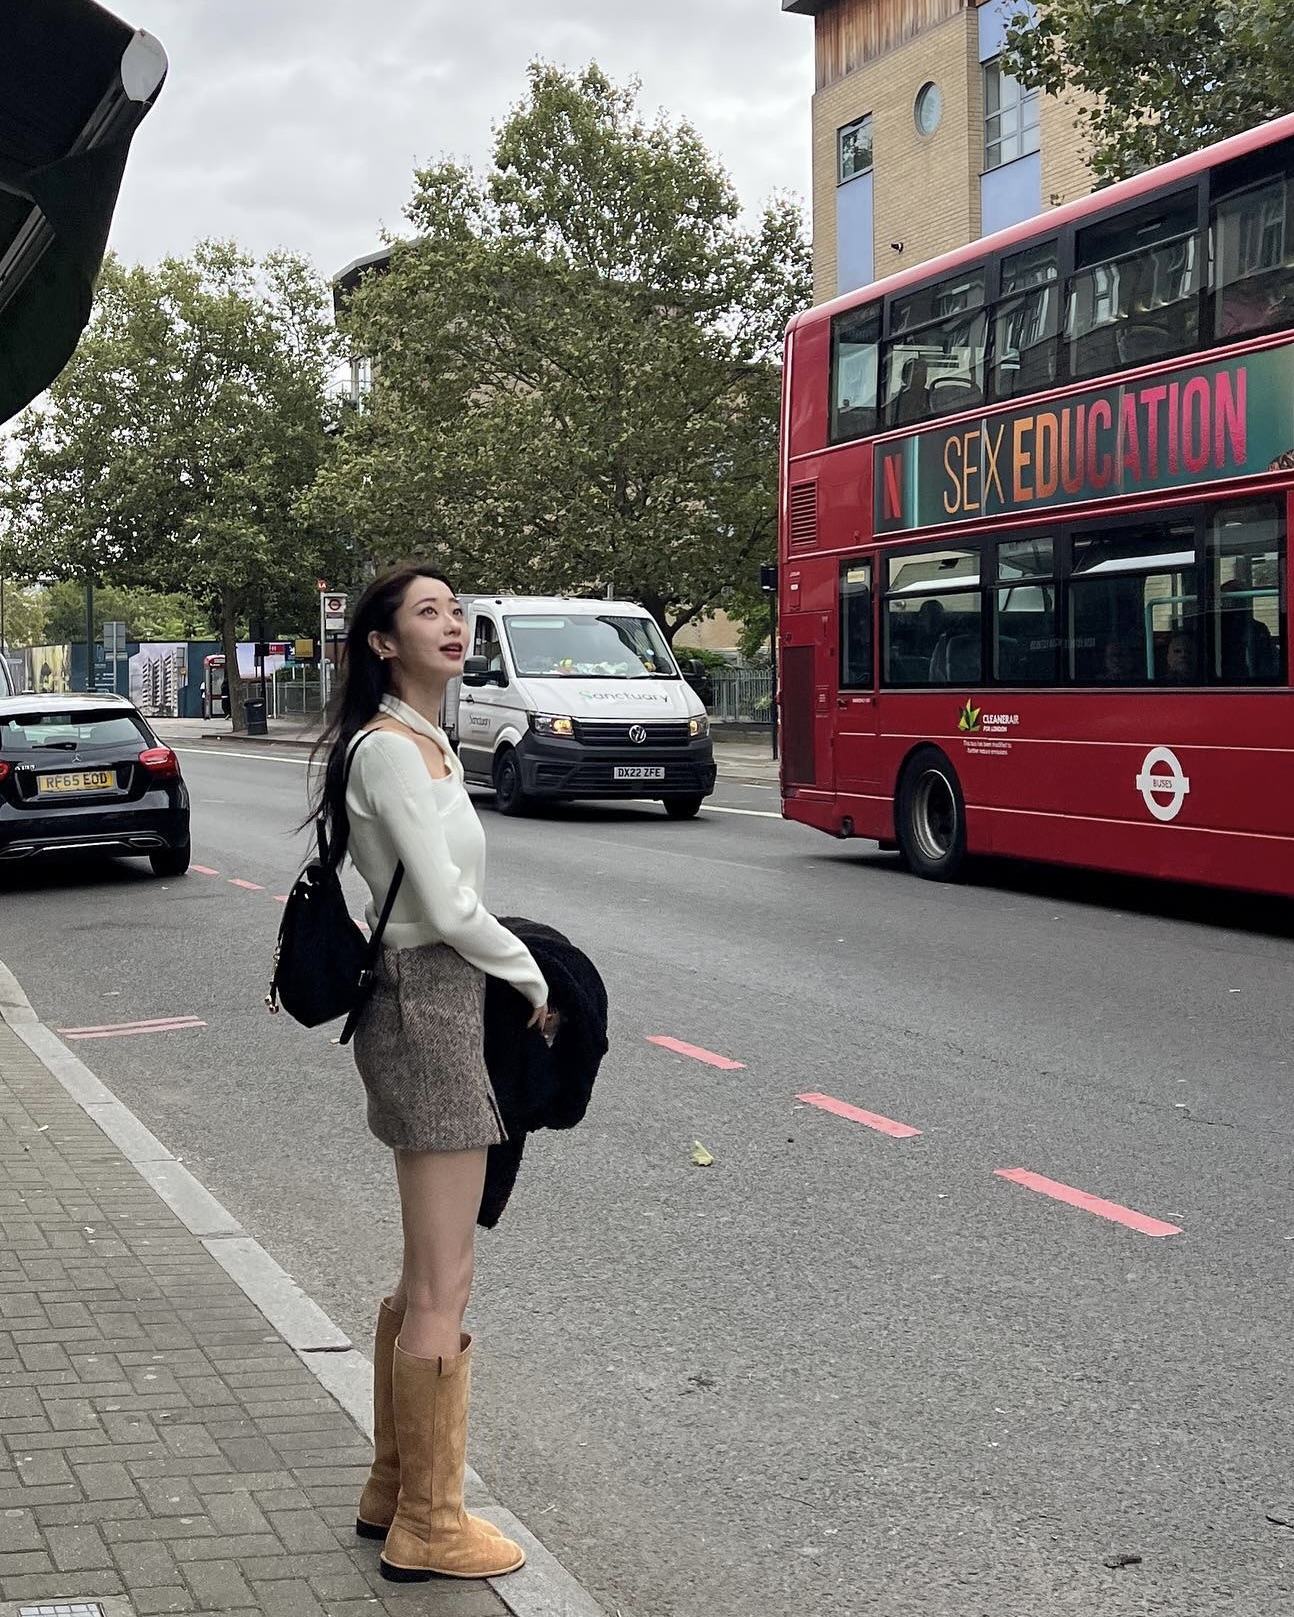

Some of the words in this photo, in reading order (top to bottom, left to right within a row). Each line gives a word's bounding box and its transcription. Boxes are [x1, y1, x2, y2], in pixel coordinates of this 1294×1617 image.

[943, 424, 1005, 513] SEX
[1013, 367, 1247, 502] EDUCATION
[579, 690, 669, 703] Sanctuary
[618, 768, 641, 777] DX22
[643, 768, 661, 777] ZFE
[46, 774, 80, 789] RF65
[83, 772, 108, 786] EOD
[1153, 779, 1173, 789] BUSES
